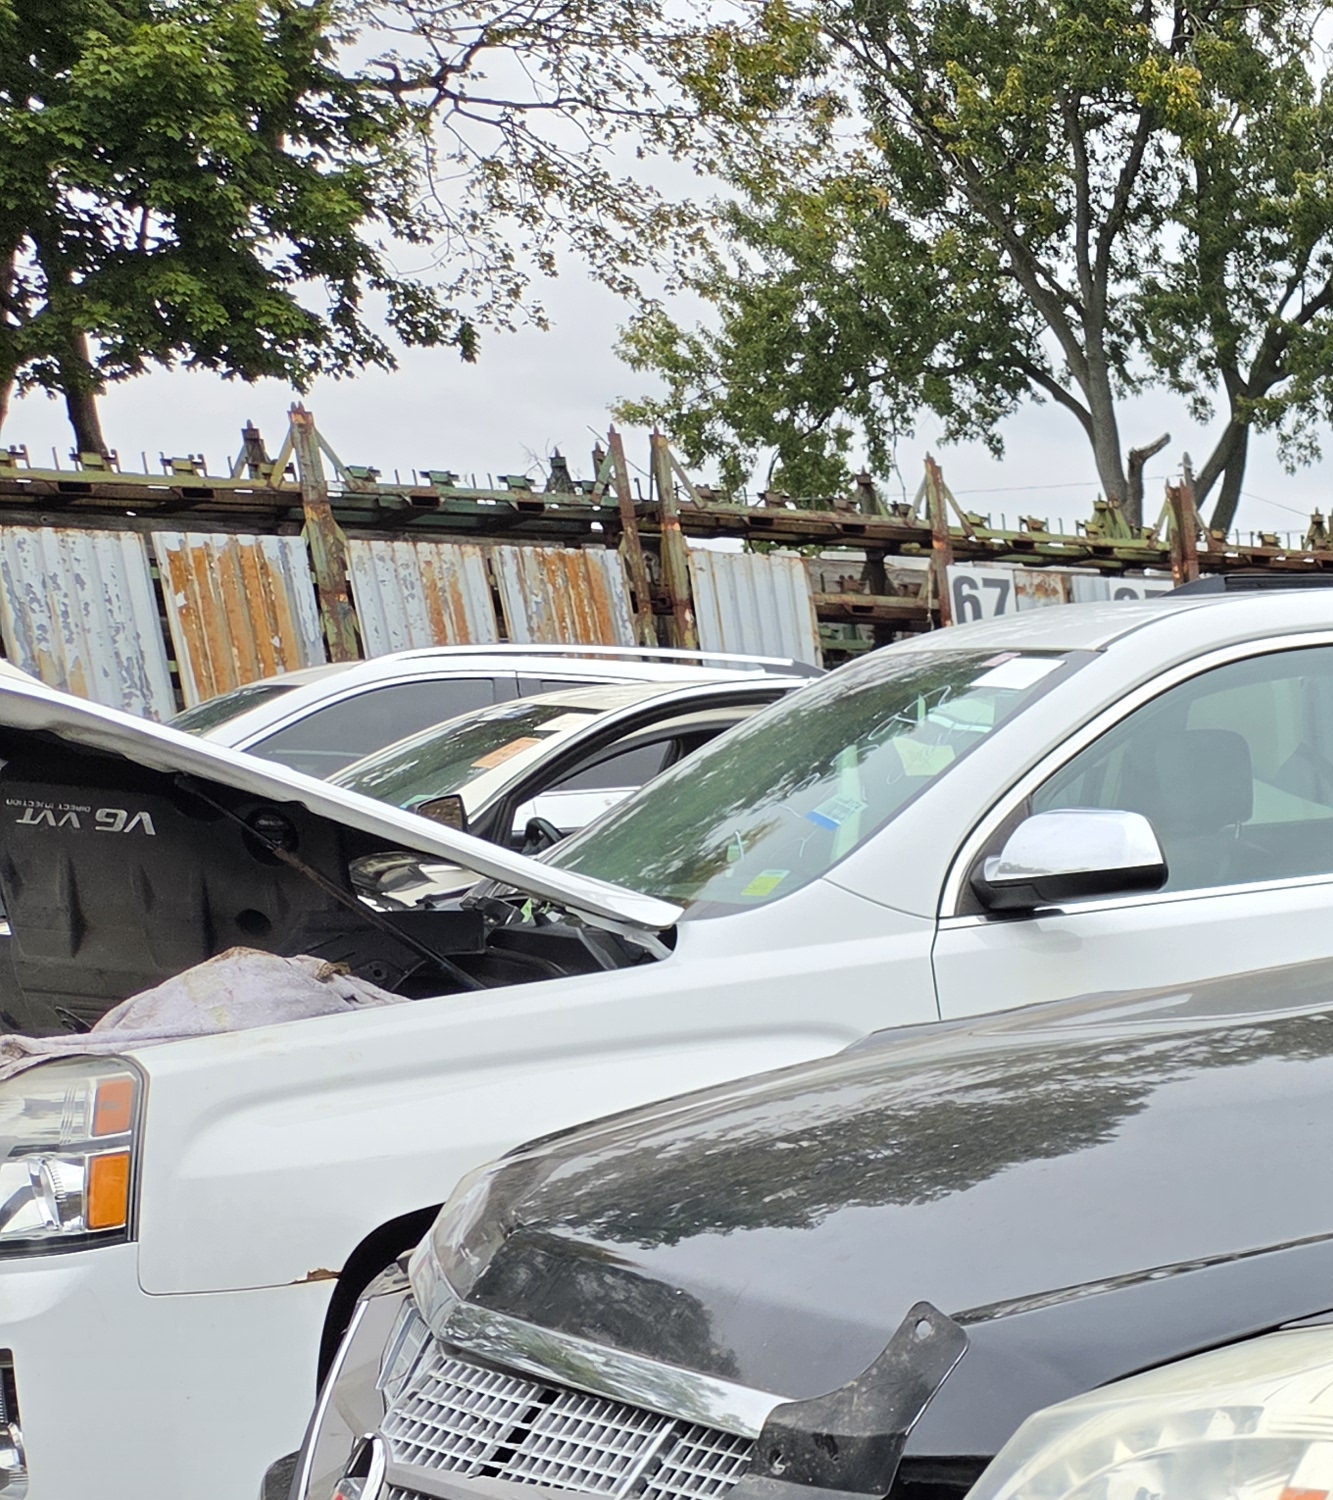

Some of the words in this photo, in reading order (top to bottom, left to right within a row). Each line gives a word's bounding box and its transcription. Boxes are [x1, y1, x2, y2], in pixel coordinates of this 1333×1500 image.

[952, 575, 1011, 625] 67
[6, 798, 55, 809] INJECTION
[58, 803, 91, 812] DIRECT
[15, 807, 81, 829] VVT
[95, 808, 156, 835] V6
